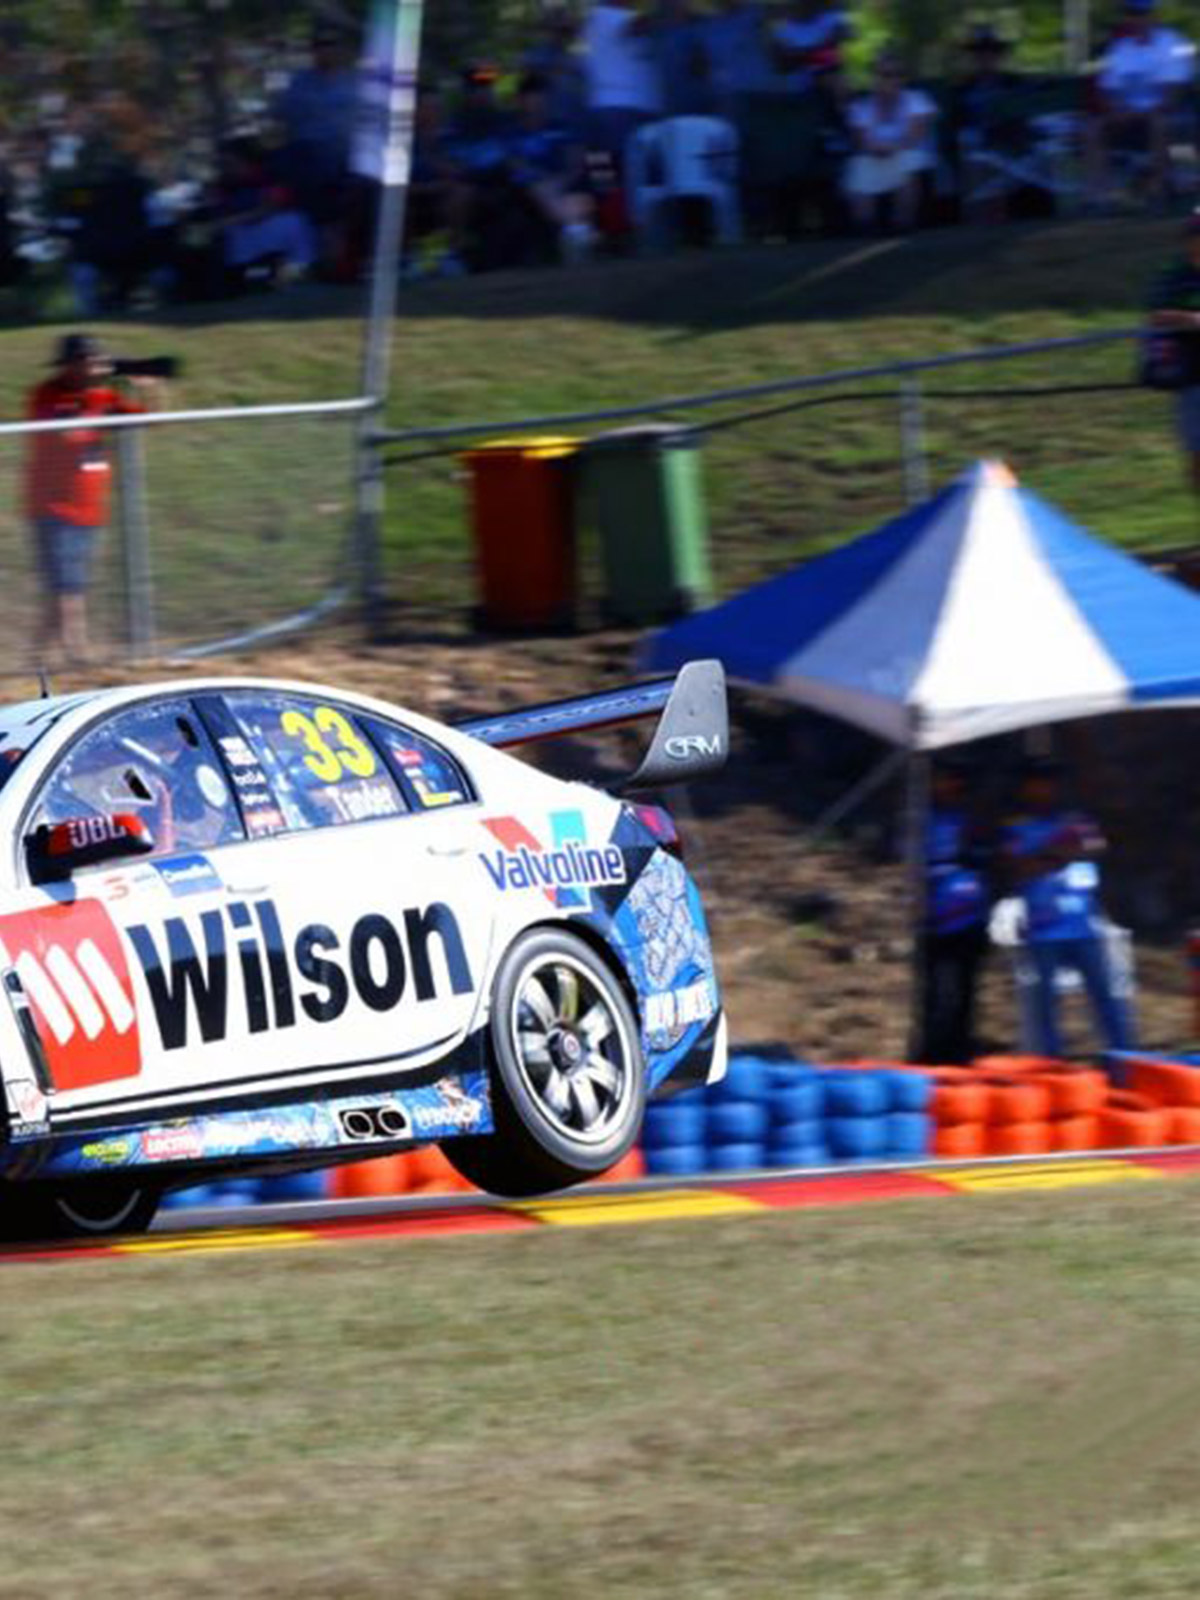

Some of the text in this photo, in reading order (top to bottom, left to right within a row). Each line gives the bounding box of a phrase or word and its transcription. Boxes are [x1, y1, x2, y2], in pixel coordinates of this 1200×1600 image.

[280, 706, 376, 783] 33
[665, 733, 721, 759] GRM
[69, 815, 126, 848] JBL
[479, 842, 623, 892] Valvoline
[126, 899, 476, 1051] Wilson
